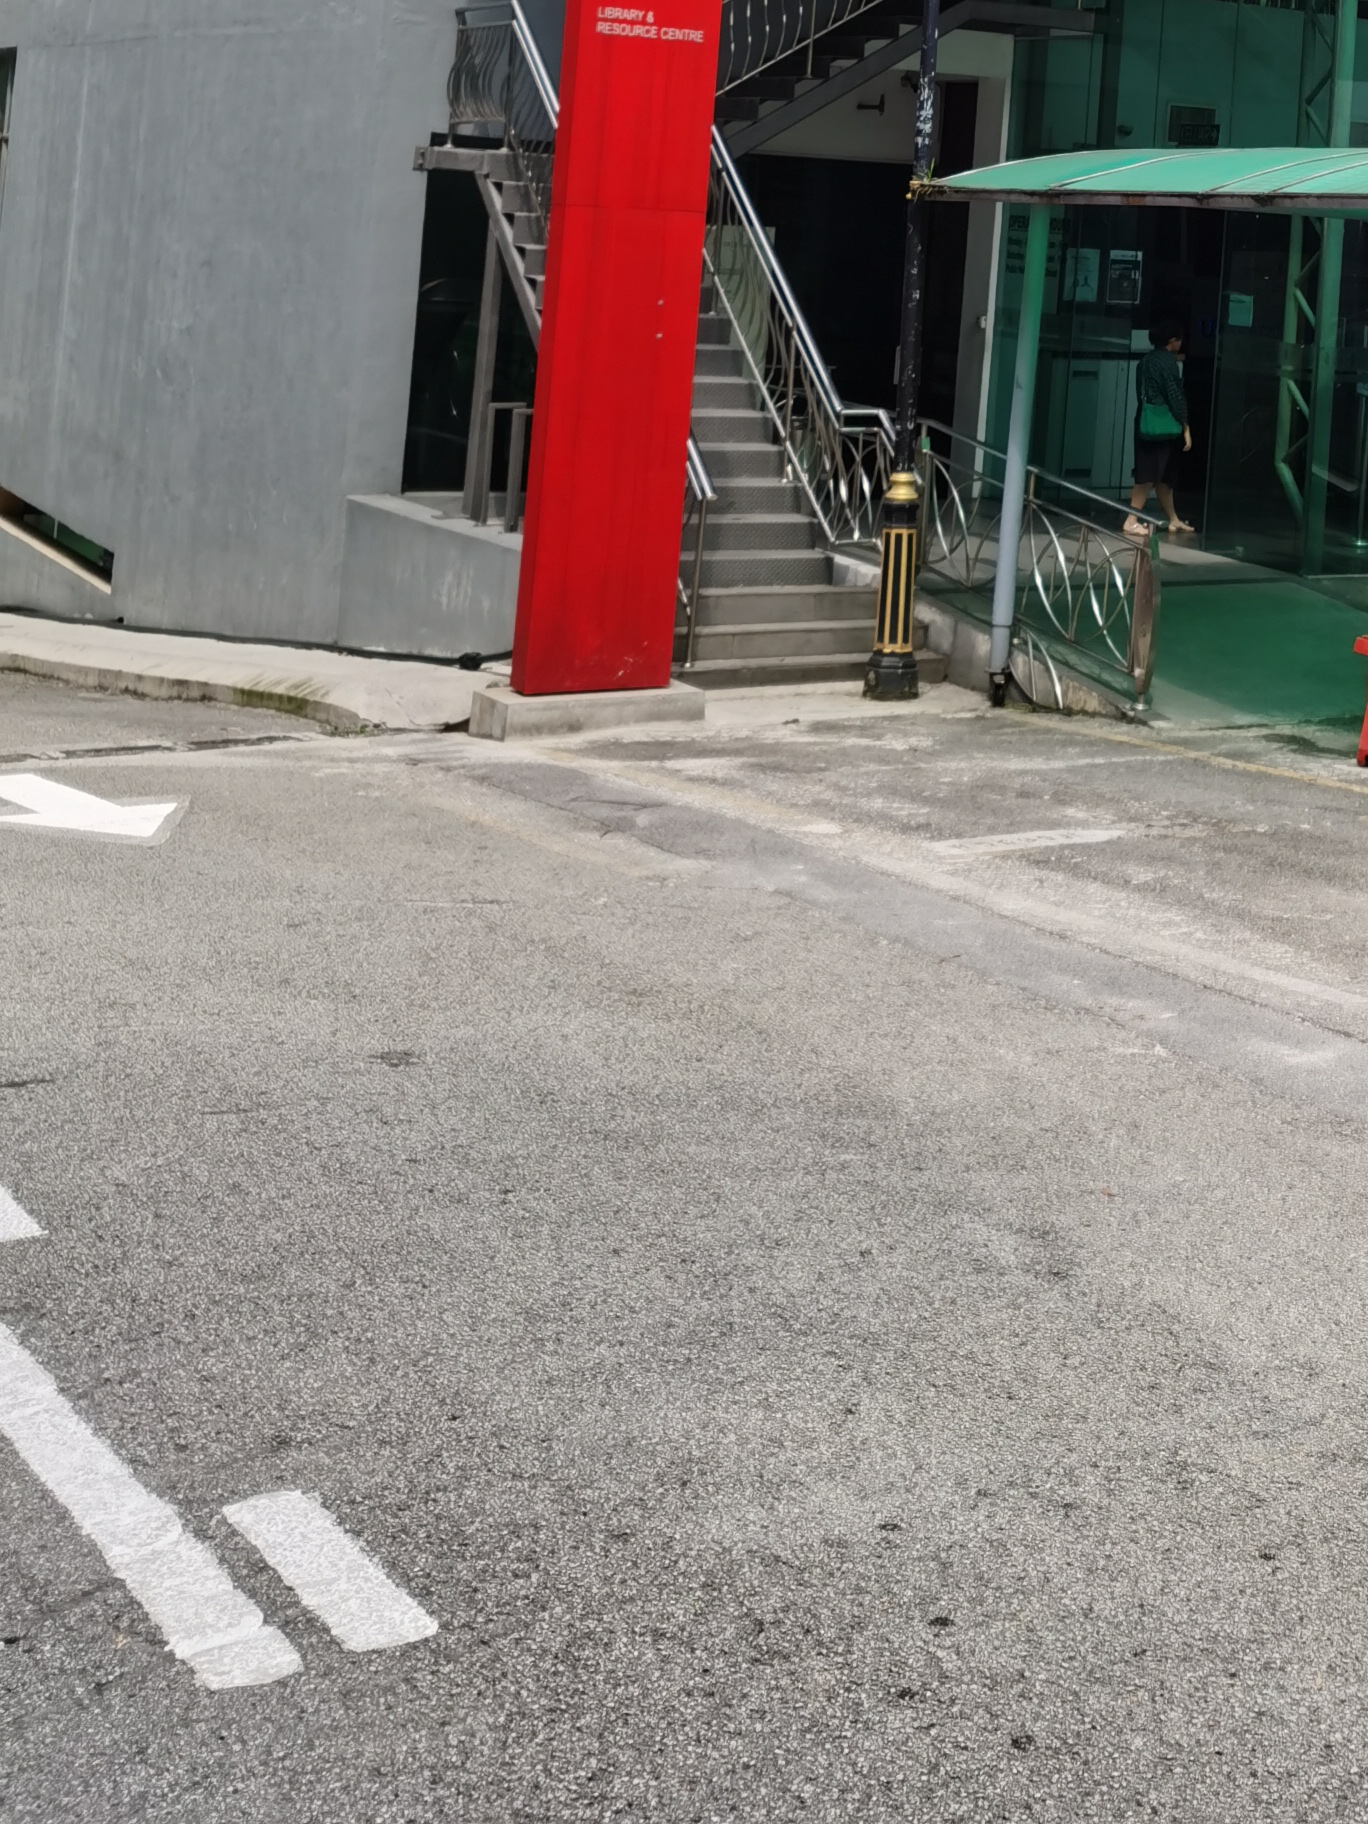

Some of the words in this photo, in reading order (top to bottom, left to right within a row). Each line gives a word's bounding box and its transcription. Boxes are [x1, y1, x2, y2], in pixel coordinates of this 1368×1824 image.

[597, 6, 645, 22] LIBRARY
[646, 10, 655, 24] &
[596, 21, 658, 39] RESOURCE
[660, 27, 704, 43] CENTRE
